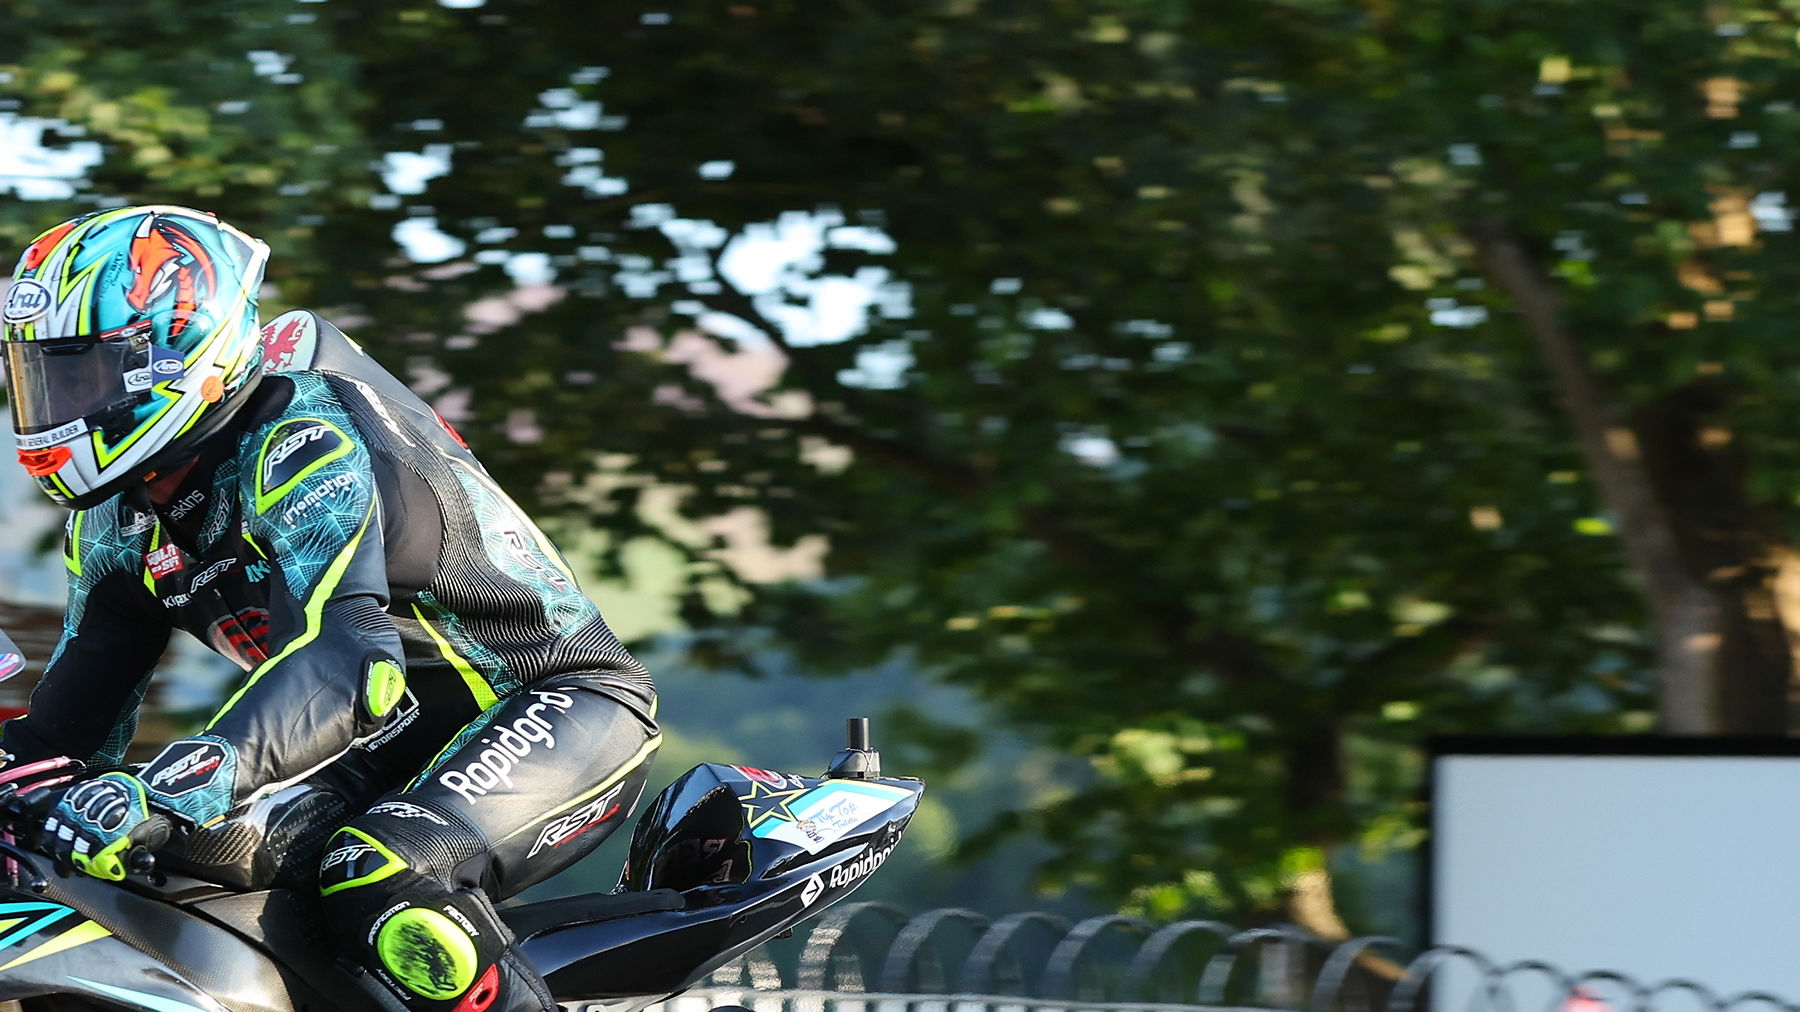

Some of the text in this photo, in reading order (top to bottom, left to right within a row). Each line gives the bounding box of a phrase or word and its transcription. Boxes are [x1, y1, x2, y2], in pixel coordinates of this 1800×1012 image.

[52, 424, 79, 441] BUILDER
[263, 425, 333, 484] RST
[190, 557, 237, 594] RST
[365, 708, 420, 753] OTORSPORT
[151, 745, 210, 786] RST
[527, 780, 626, 859] RST
[829, 831, 903, 889] Rapidgri
